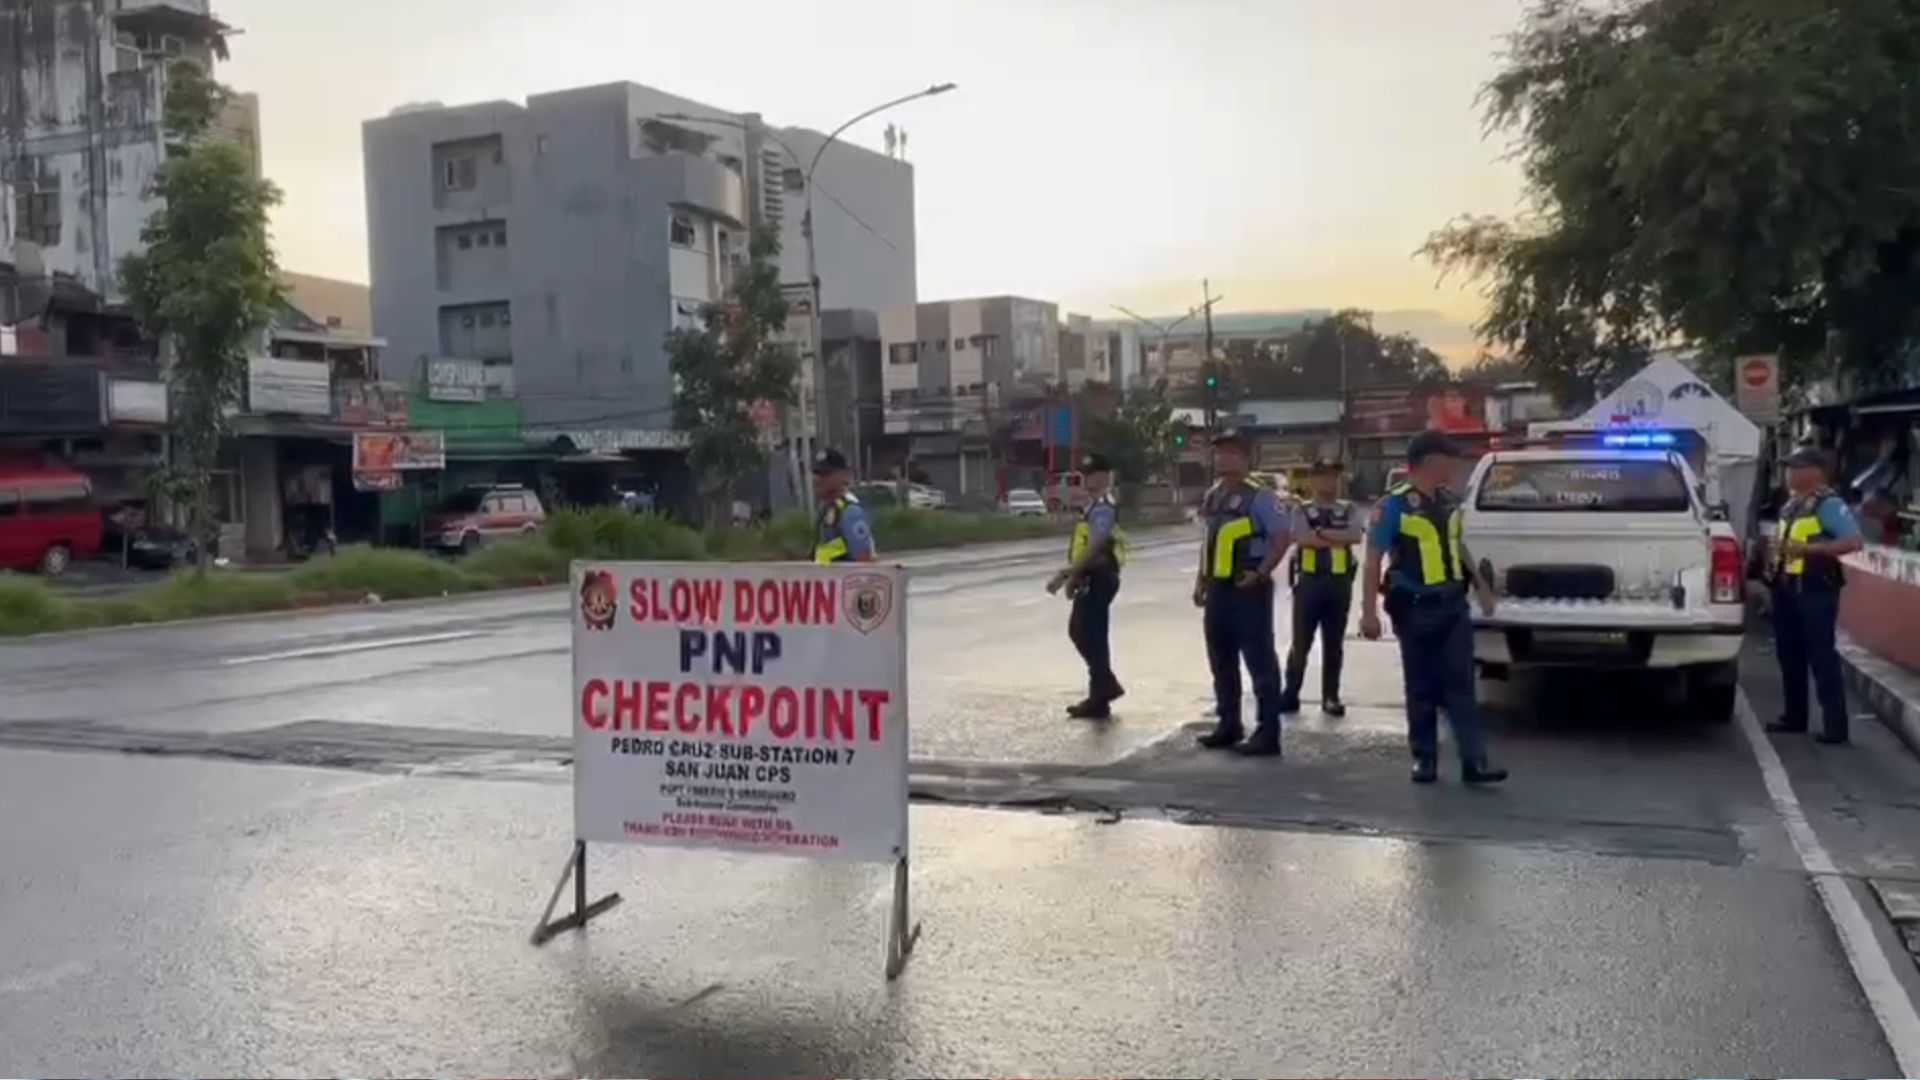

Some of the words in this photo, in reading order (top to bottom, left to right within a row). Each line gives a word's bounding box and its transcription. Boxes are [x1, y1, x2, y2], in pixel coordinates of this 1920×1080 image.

[629, 578, 722, 624] SLOW
[734, 579, 835, 625] DOWN
[680, 630, 782, 674] PNP
[581, 679, 889, 741] CHECKPOINT
[611, 737, 665, 756] PEDRO
[669, 740, 714, 759] CRUZ
[719, 743, 838, 765] SUB-STATION
[844, 748, 855, 765] 7
[665, 760, 699, 779] SAN
[703, 763, 749, 781] JUAN
[755, 765, 791, 783] CPS
